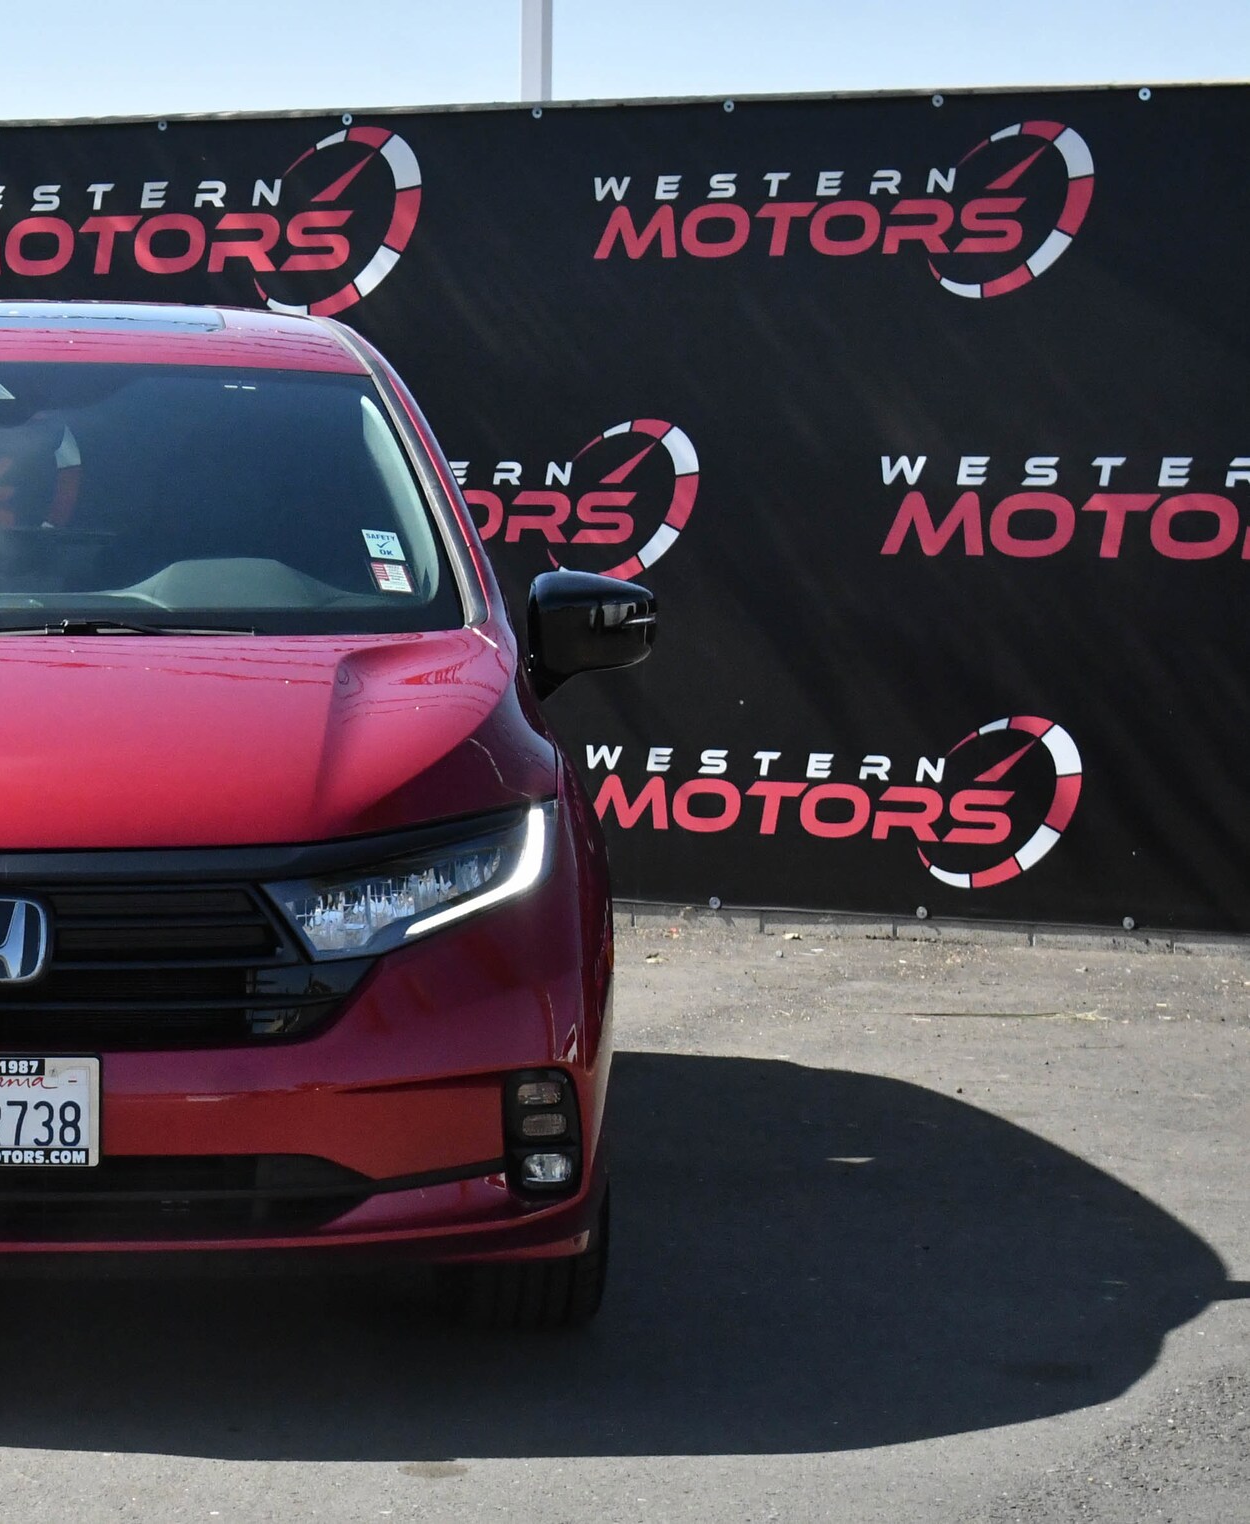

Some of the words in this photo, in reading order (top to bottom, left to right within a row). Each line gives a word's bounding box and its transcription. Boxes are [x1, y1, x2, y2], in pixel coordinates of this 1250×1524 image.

[594, 168, 956, 201] WESTERN
[593, 197, 1027, 259] MOTORS
[366, 533, 395, 541] SAFETY
[881, 491, 1250, 560] MOTO
[586, 744, 946, 784] WESTERN
[593, 774, 1015, 844] MOTORS
[0, 1060, 39, 1074] 1987
